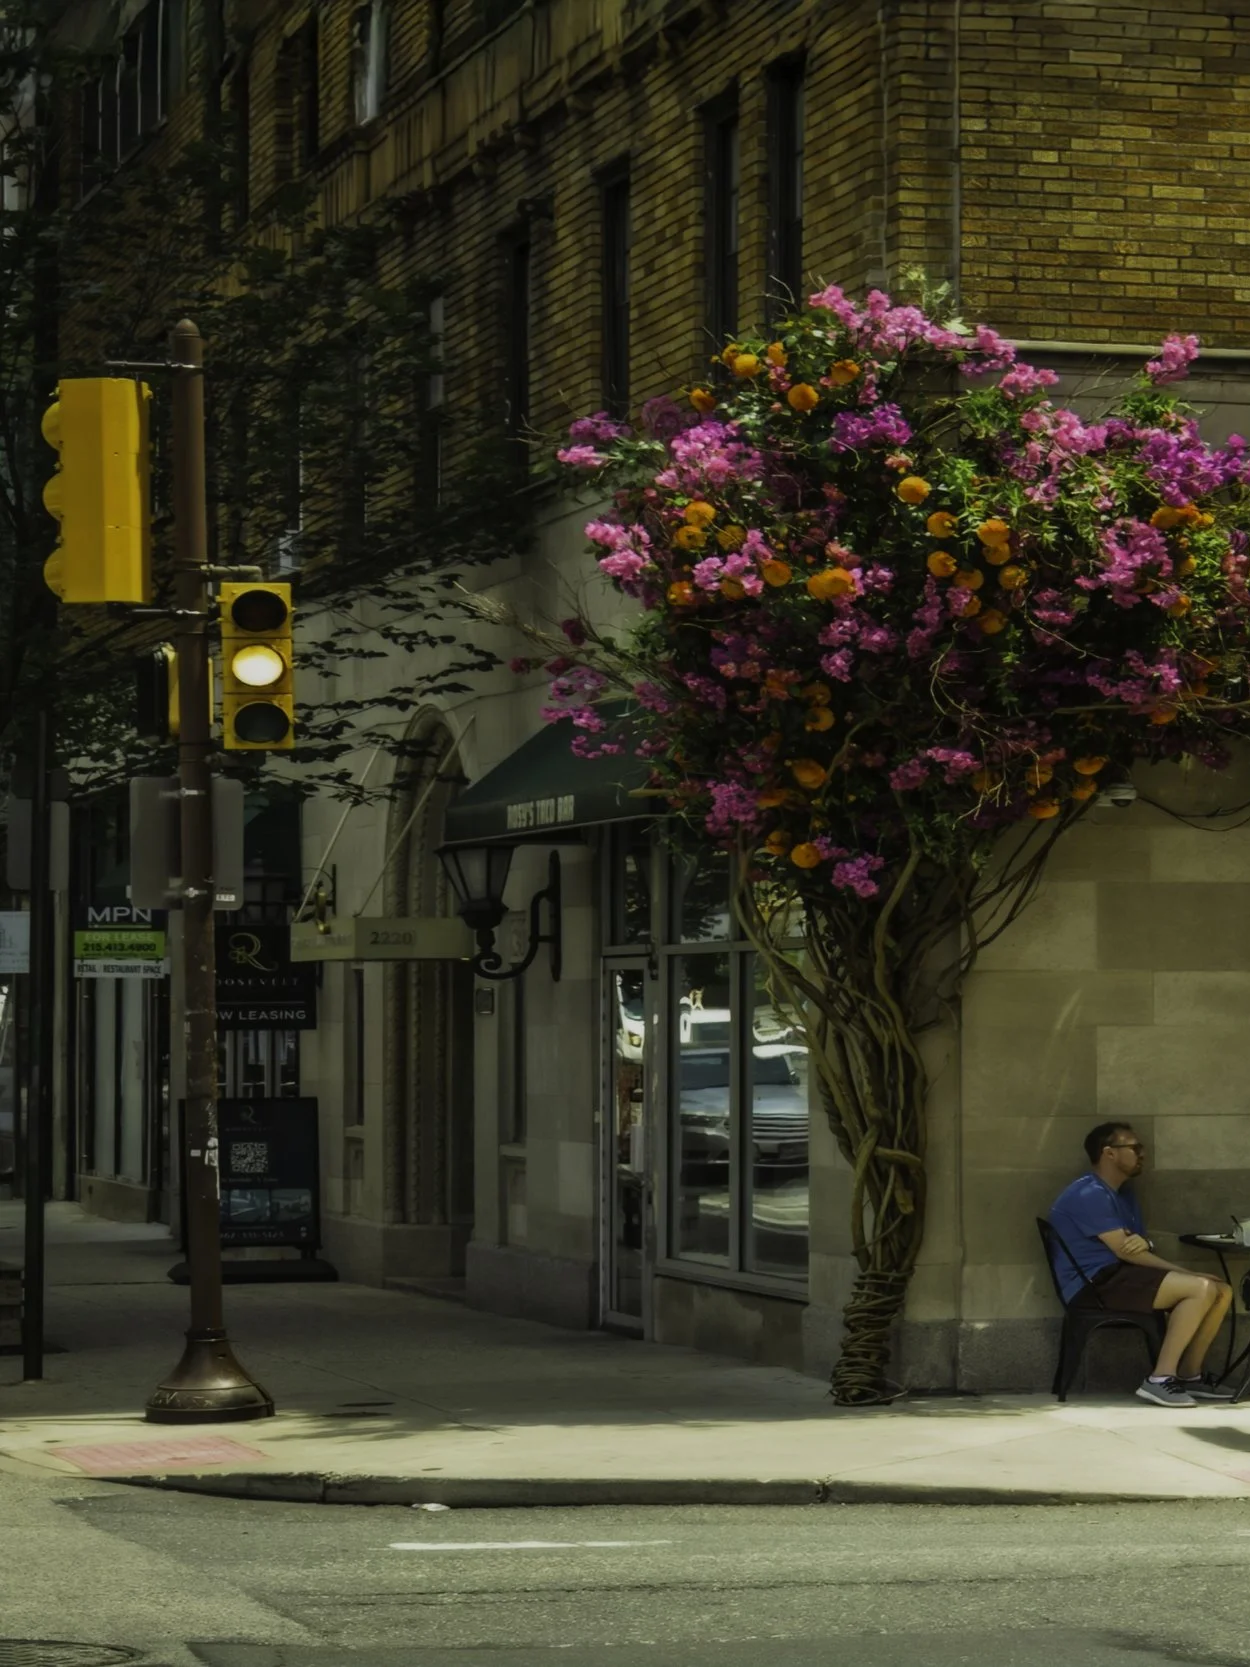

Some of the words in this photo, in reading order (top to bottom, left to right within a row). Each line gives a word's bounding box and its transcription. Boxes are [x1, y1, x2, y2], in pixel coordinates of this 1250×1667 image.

[88, 906, 152, 922] MPN
[85, 932, 110, 941] FOR
[114, 932, 154, 941] LEASE
[103, 964, 141, 973] RESTAURANT
[143, 964, 161, 974] SPACE
[239, 1010, 306, 1021] LEASING
